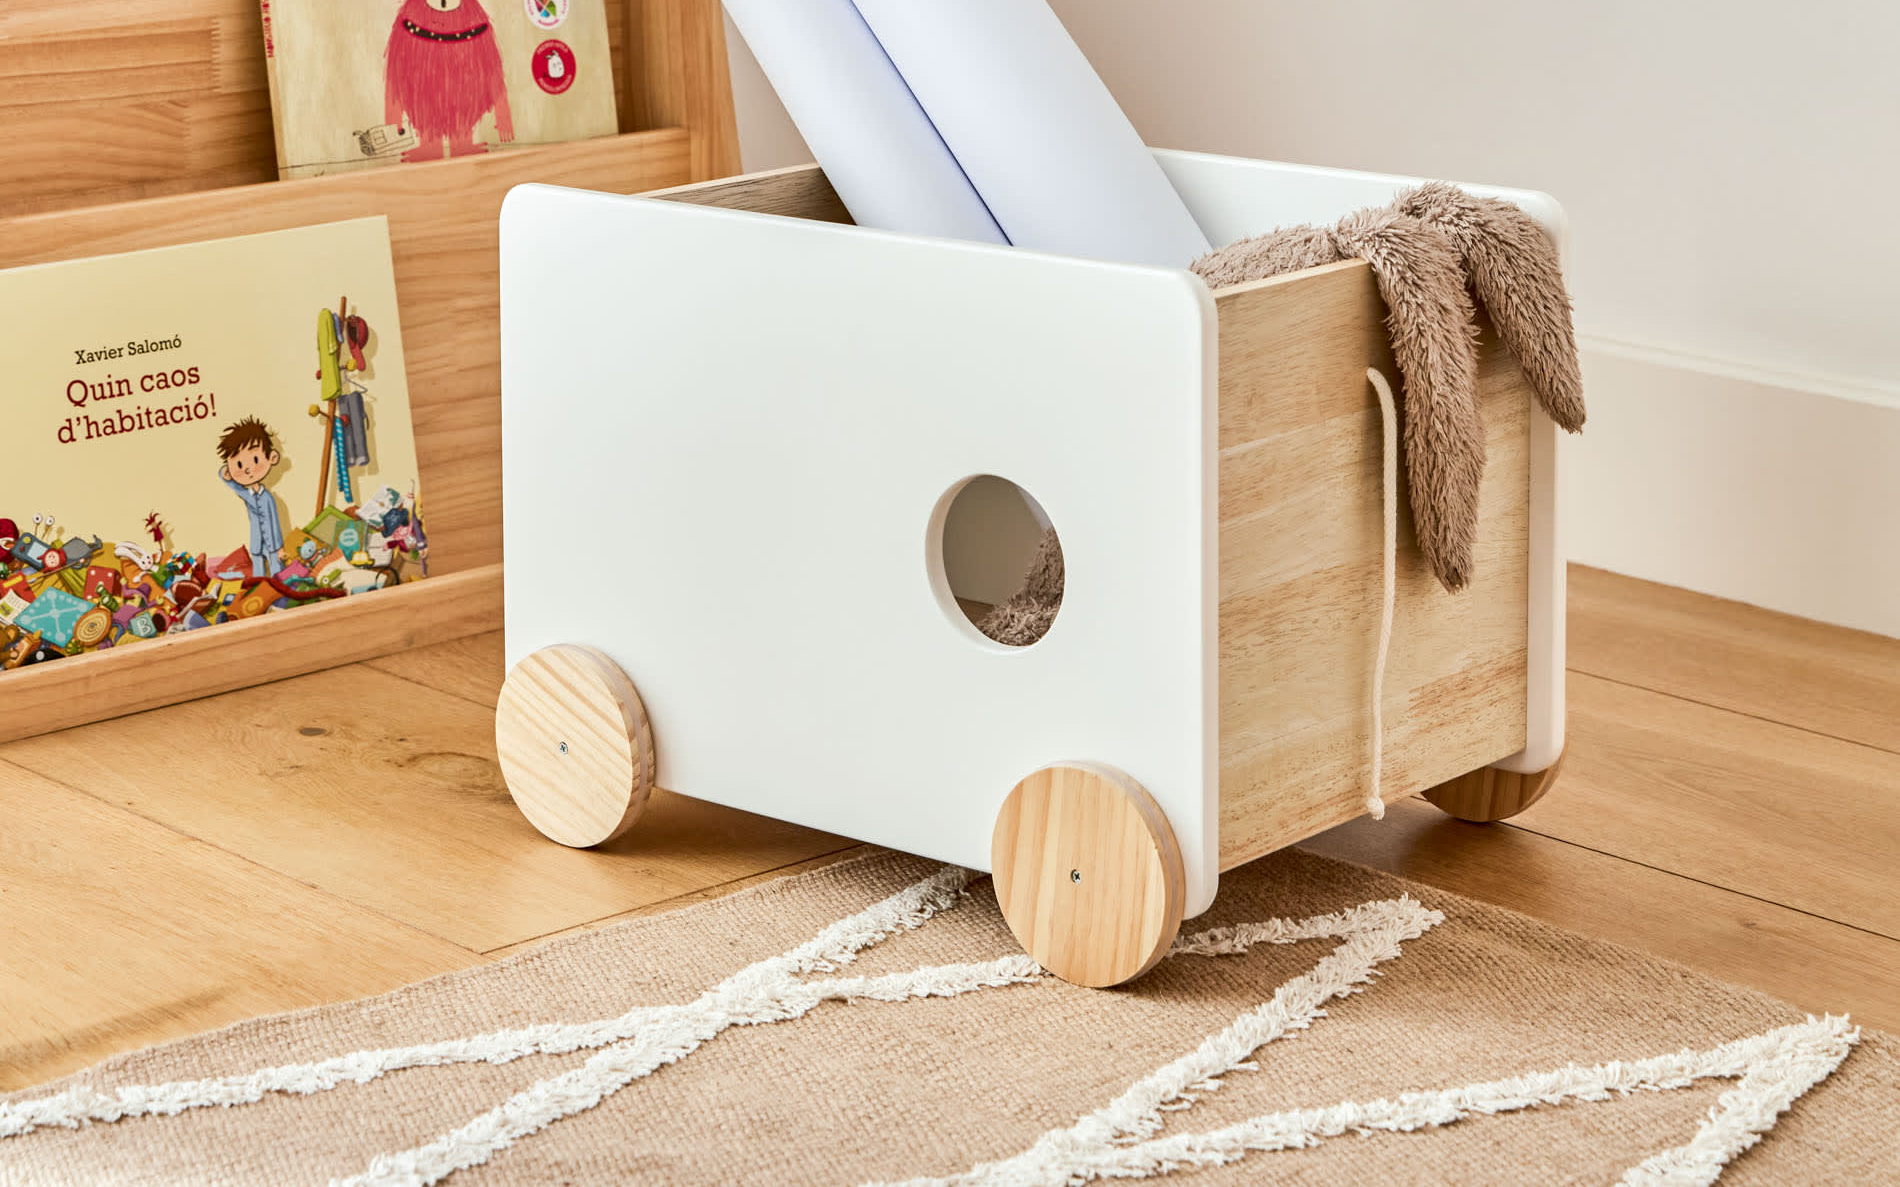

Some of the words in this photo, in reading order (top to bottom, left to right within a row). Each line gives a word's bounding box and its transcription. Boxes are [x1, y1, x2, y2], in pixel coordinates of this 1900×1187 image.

[74, 346, 125, 365] Xavier
[127, 334, 182, 356] Salomó
[66, 374, 134, 408] Quin
[140, 366, 201, 393] caos
